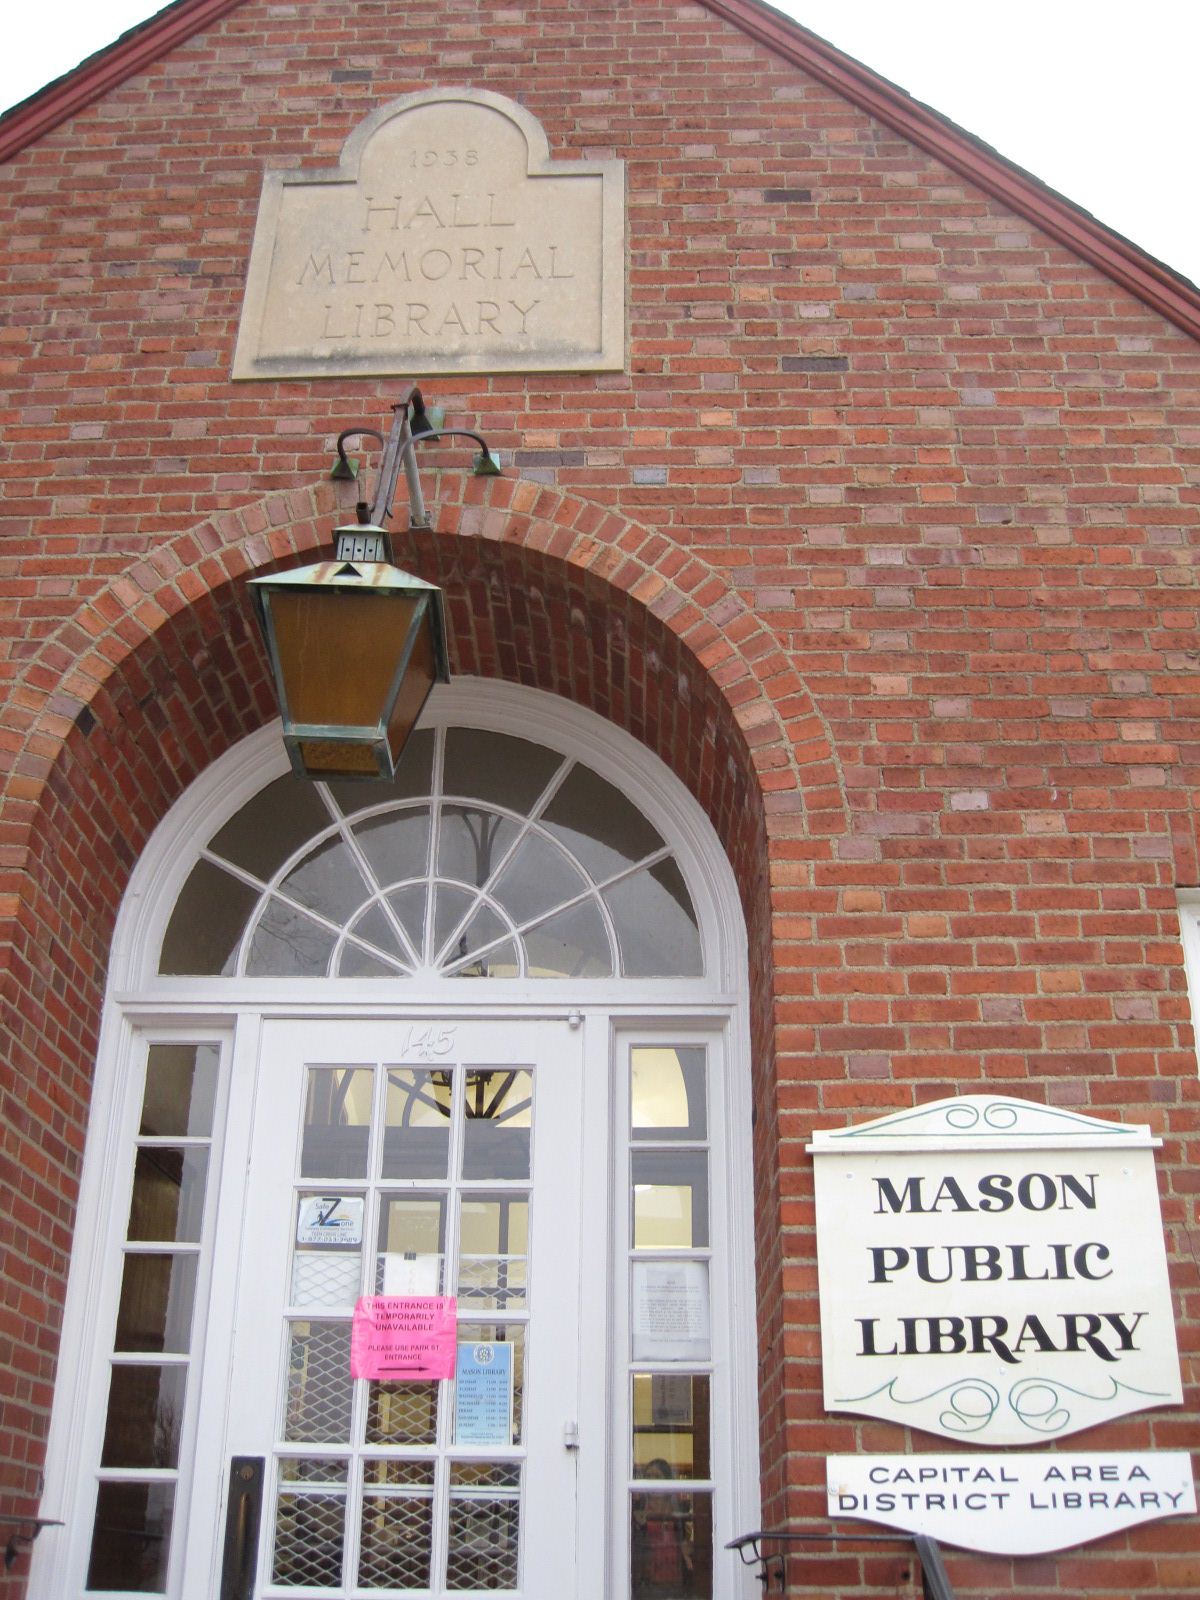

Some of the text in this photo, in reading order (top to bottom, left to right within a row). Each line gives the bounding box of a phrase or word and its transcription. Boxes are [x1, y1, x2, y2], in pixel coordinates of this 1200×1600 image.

[408, 149, 480, 168] 1938
[361, 193, 516, 232] HALL
[295, 246, 576, 285] MEMORIAL
[320, 300, 542, 339] LIBRARY
[401, 1025, 458, 1057] 145
[871, 1173, 1100, 1214] MASON
[866, 1242, 1113, 1283] PUBLIC
[366, 1302, 385, 1310] THIS
[387, 1302, 434, 1310] ENTRANCE
[375, 1312, 435, 1320] TEMPORARILY
[375, 1323, 434, 1331] UNAVAILABLE
[368, 1344, 393, 1352] PLEASE
[395, 1344, 409, 1352] USE
[410, 1344, 429, 1352] PARK
[854, 1312, 1149, 1364] LIBRARY
[384, 1353, 422, 1361] ENTRANCE
[869, 1465, 1150, 1484] CAPITAL AREA
[838, 1491, 1184, 1512] DISTRICT LIBRARY
